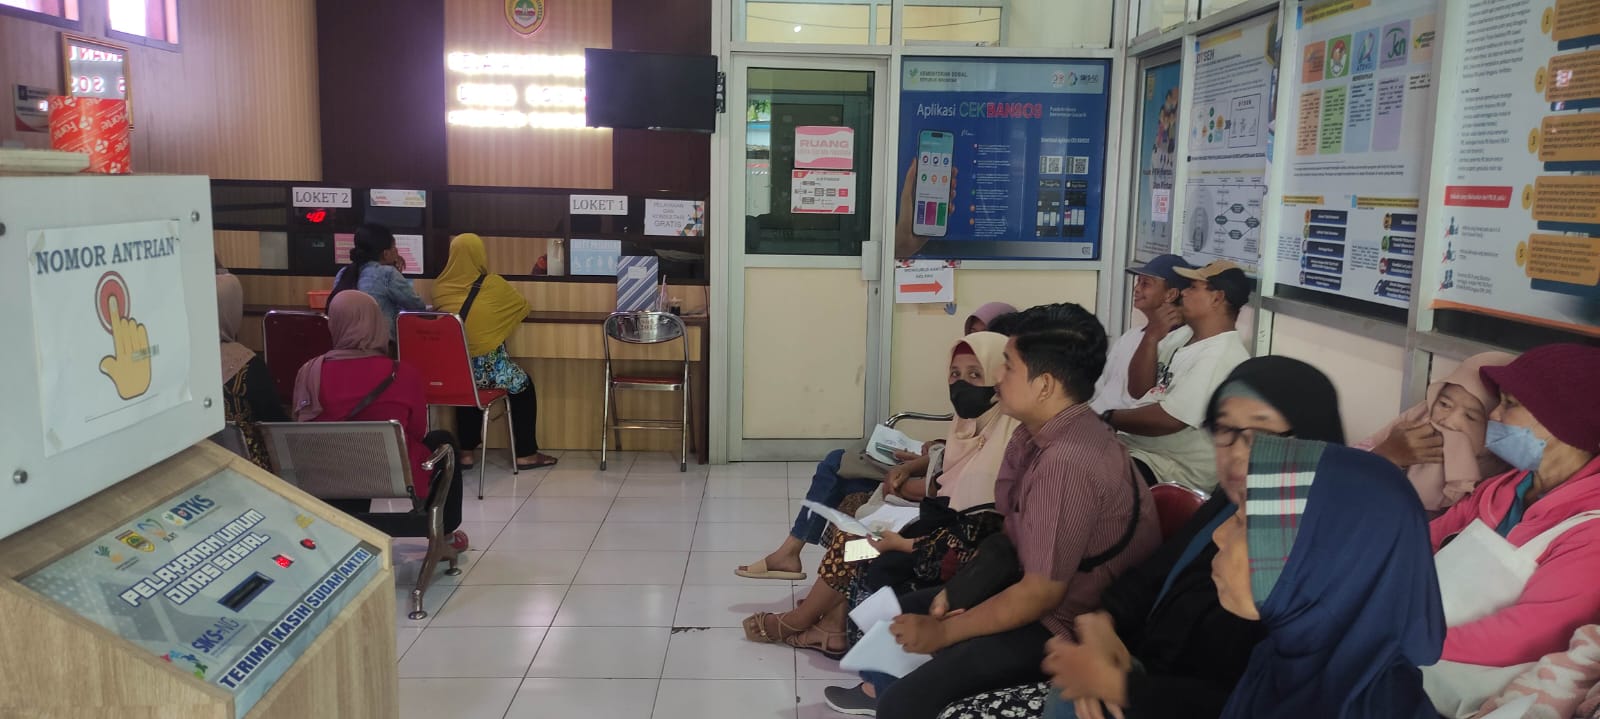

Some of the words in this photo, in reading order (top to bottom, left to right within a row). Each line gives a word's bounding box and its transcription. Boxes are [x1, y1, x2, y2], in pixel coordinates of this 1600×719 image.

[917, 104, 956, 118] Aplikasi
[799, 139, 849, 148] RUANG
[295, 191, 338, 203] LOKET
[342, 192, 349, 203] 2
[572, 199, 615, 211] LOKET
[618, 200, 625, 211] 1
[35, 245, 107, 275] NOMOR
[111, 236, 176, 264] ANTRIAN
[119, 535, 224, 607] PELAYANAN
[216, 509, 265, 545] UMUM
[211, 532, 271, 570] SOSIAL
[191, 616, 241, 653] SIKS-NG
[220, 638, 278, 688] TERIMA
[270, 604, 312, 641] KASIH
[306, 572, 345, 607] SUDAH
[339, 548, 371, 576] ANTRI
